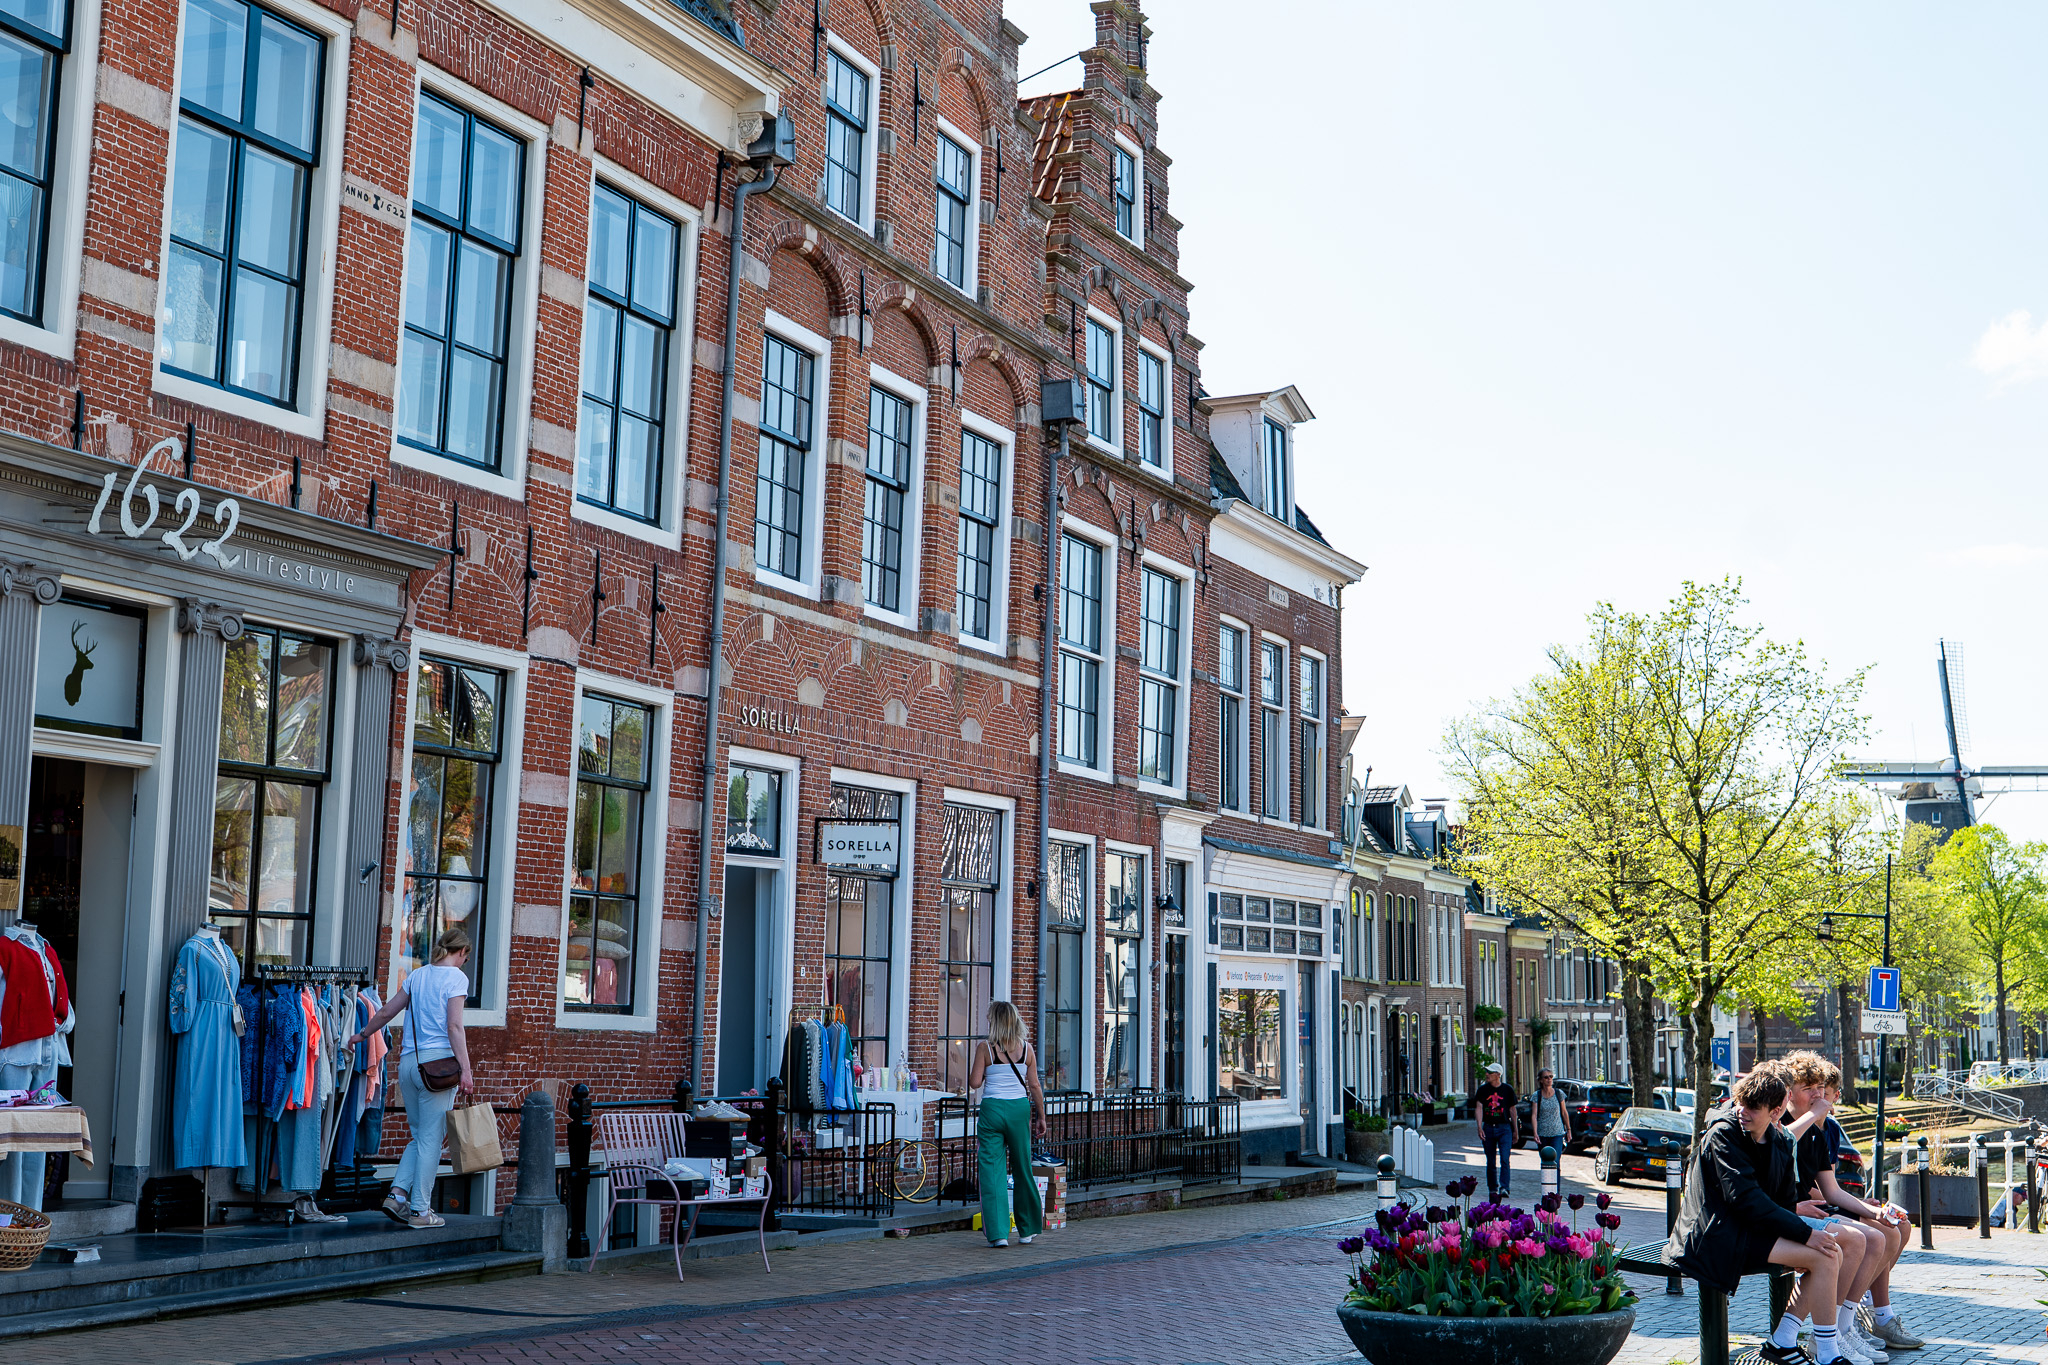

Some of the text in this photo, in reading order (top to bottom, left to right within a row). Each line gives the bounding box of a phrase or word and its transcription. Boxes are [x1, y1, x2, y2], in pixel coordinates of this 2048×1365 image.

[345, 185, 406, 219] ANNO 1622
[86, 436, 355, 594] 1622 lifestyle
[741, 705, 800, 736] SORELLA
[828, 839, 892, 851] SORELLA
[1230, 971, 1243, 981] Verkoop
[1247, 972, 1262, 982] Reparatie
[1862, 1012, 1906, 1020] uitgezonderd
[1717, 1047, 1725, 1060] P
